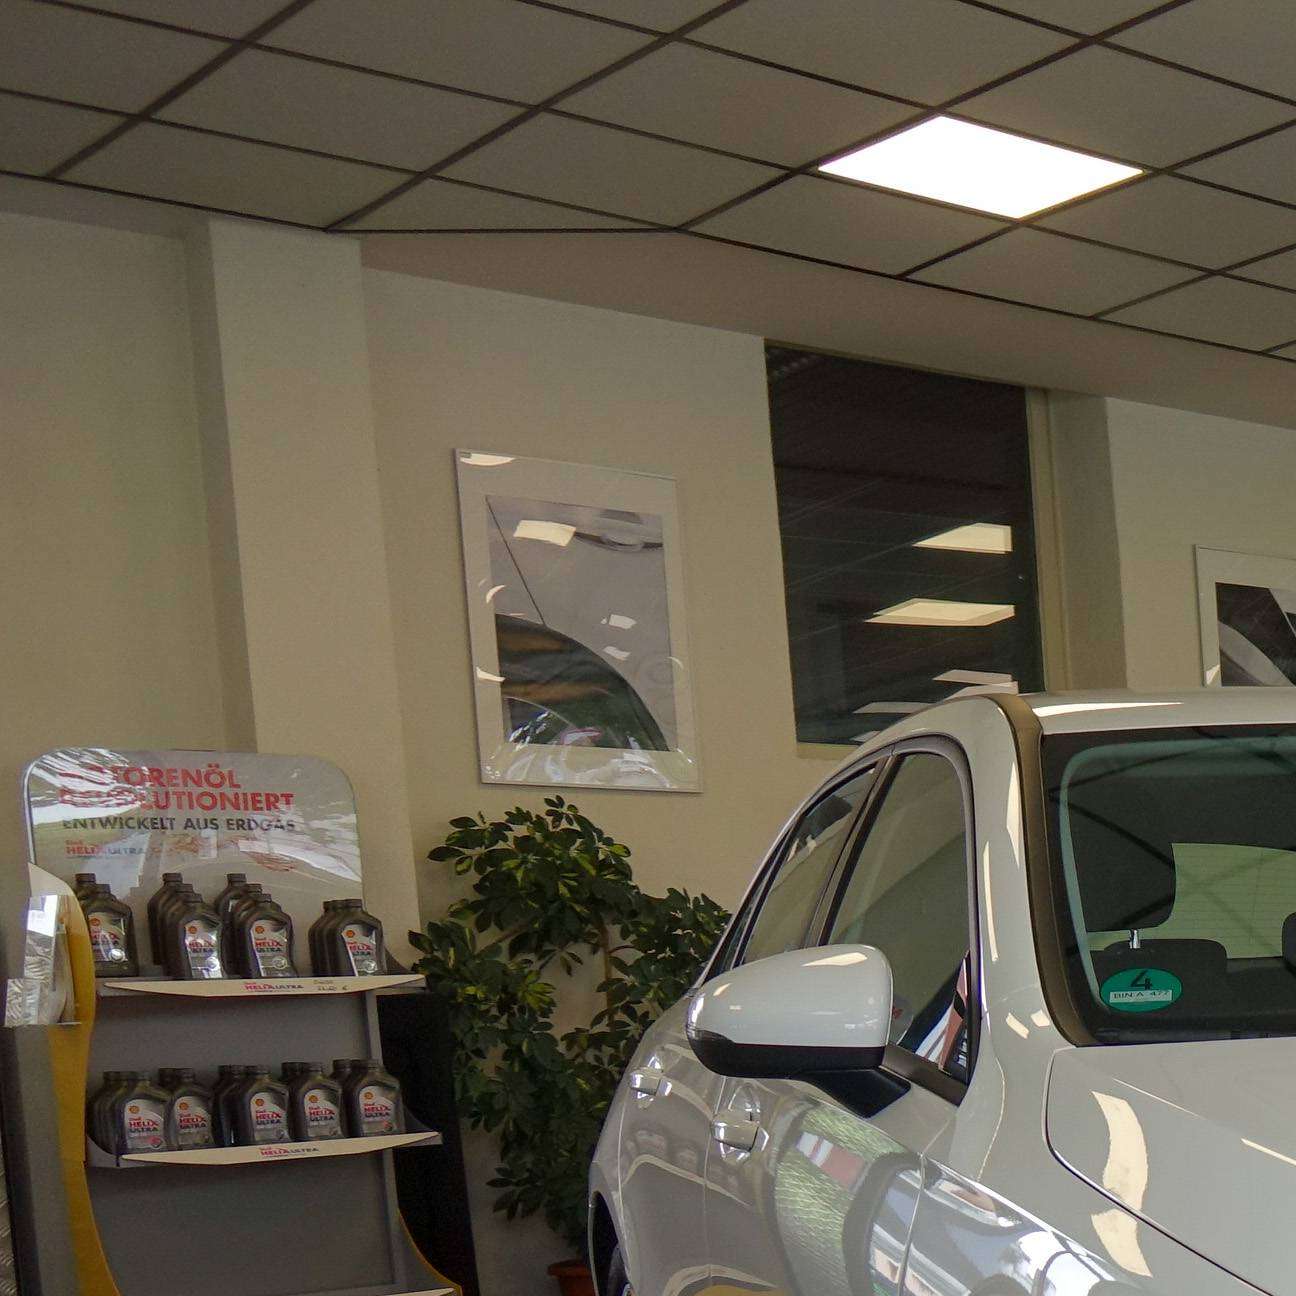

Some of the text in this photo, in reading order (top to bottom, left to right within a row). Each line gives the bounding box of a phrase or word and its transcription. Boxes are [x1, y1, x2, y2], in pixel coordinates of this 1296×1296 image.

[63, 815, 176, 831] ENTWICKELT
[183, 817, 219, 831] AUS
[1130, 970, 1153, 991] 4
